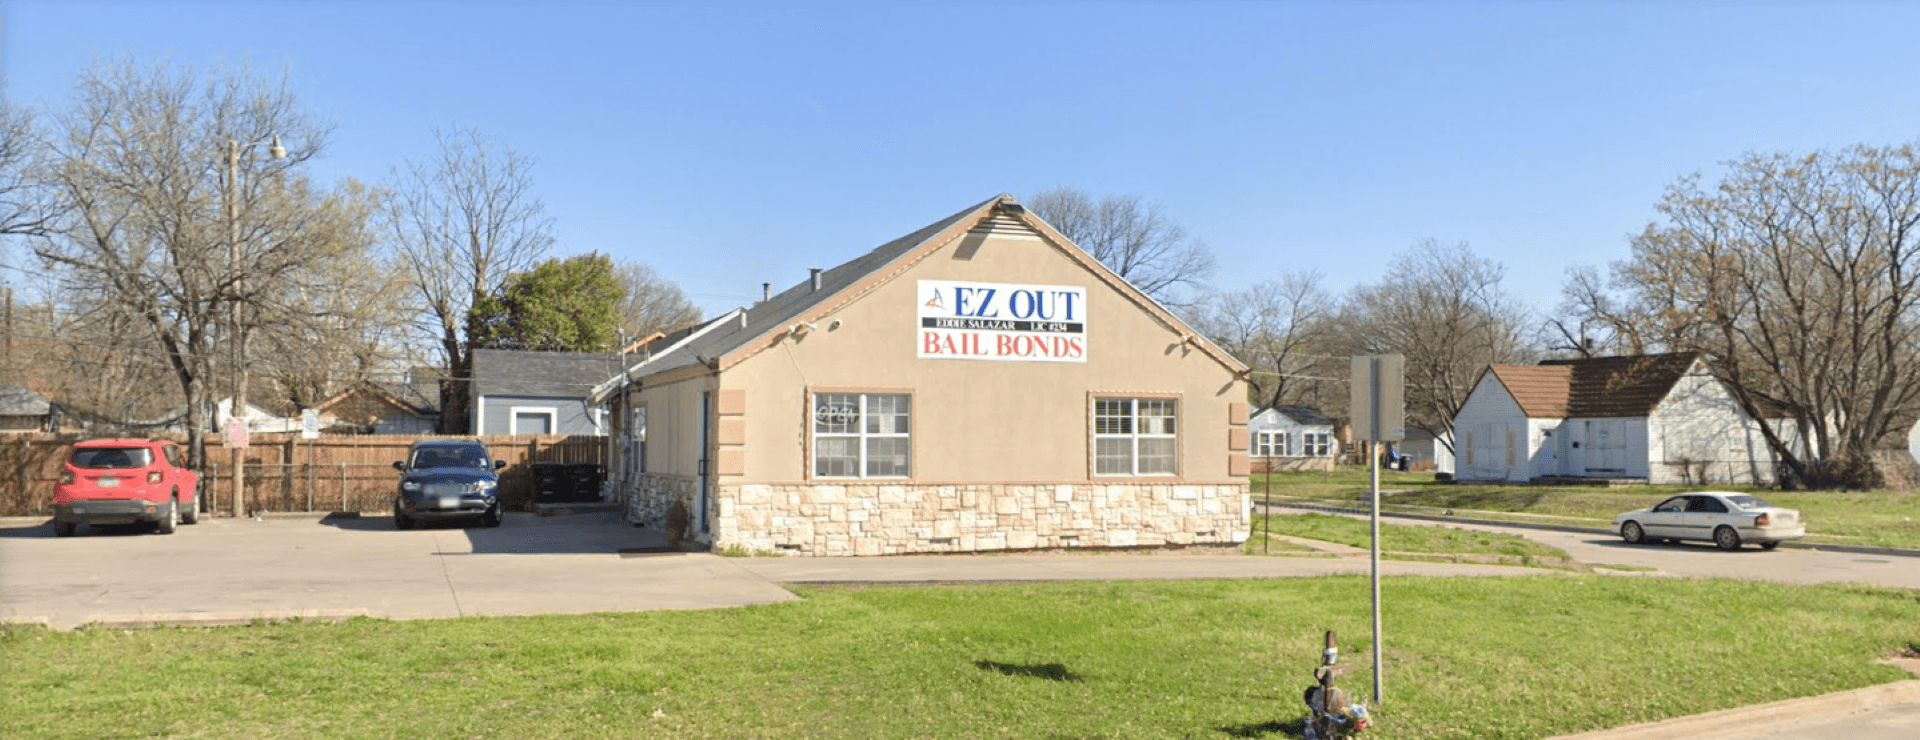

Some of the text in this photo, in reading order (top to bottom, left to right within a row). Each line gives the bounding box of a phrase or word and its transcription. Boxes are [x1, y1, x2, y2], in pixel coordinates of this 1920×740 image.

[954, 286, 1080, 320] EZ OUT
[936, 318, 967, 327] EDDIE
[969, 319, 1015, 330] SALAZAR
[923, 331, 1083, 358] BAIL BONDS
